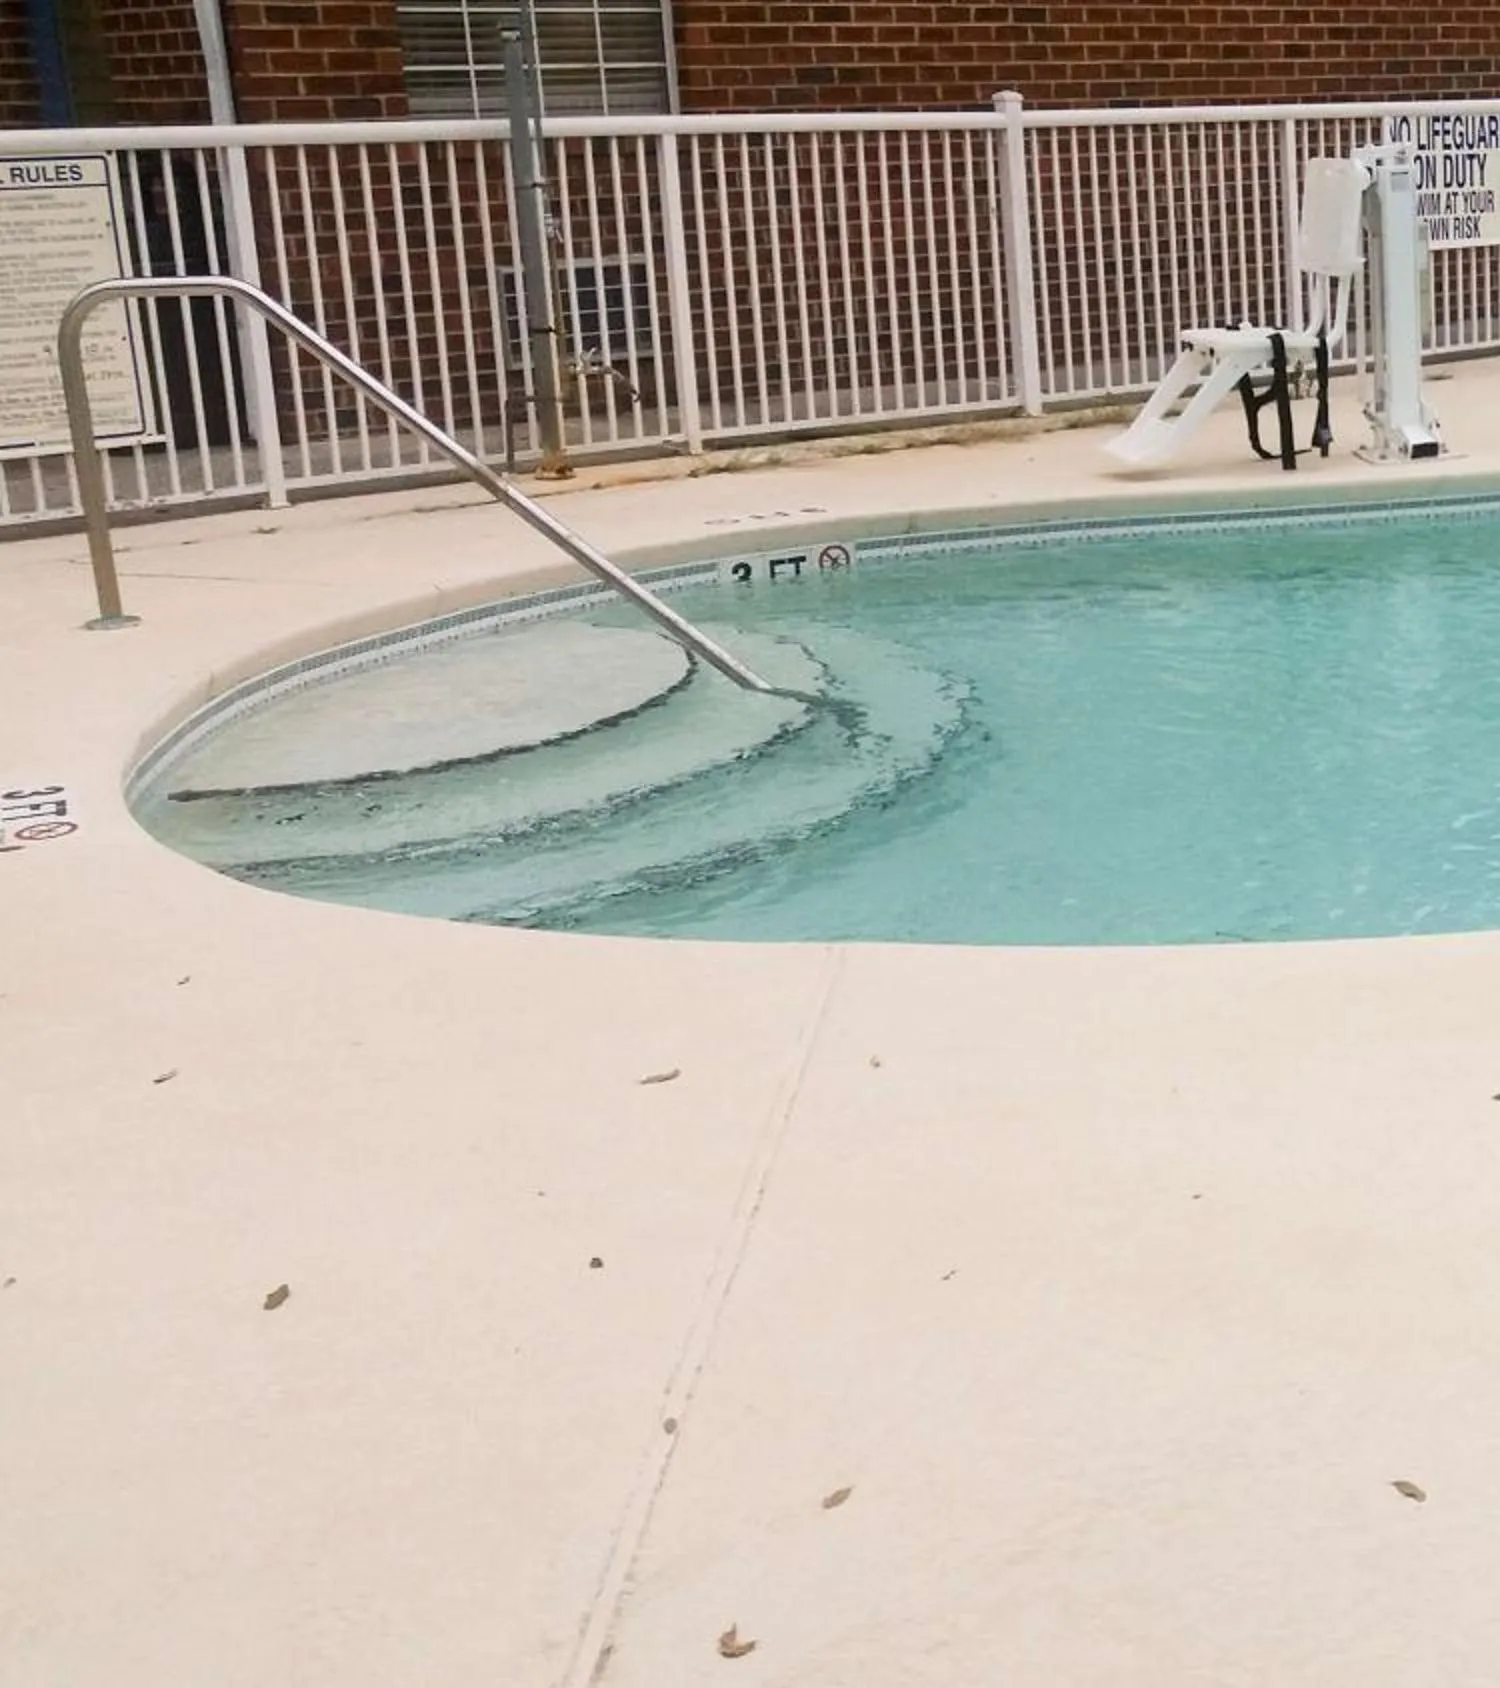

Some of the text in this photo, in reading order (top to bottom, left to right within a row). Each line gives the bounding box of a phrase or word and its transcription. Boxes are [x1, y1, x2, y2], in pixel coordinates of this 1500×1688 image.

[9, 165, 83, 183] RULES
[1443, 153, 1487, 188] DUTY
[1417, 190, 1494, 216] WIM AT YOUR
[1424, 216, 1481, 240] WN RISK
[769, 555, 807, 580] FT
